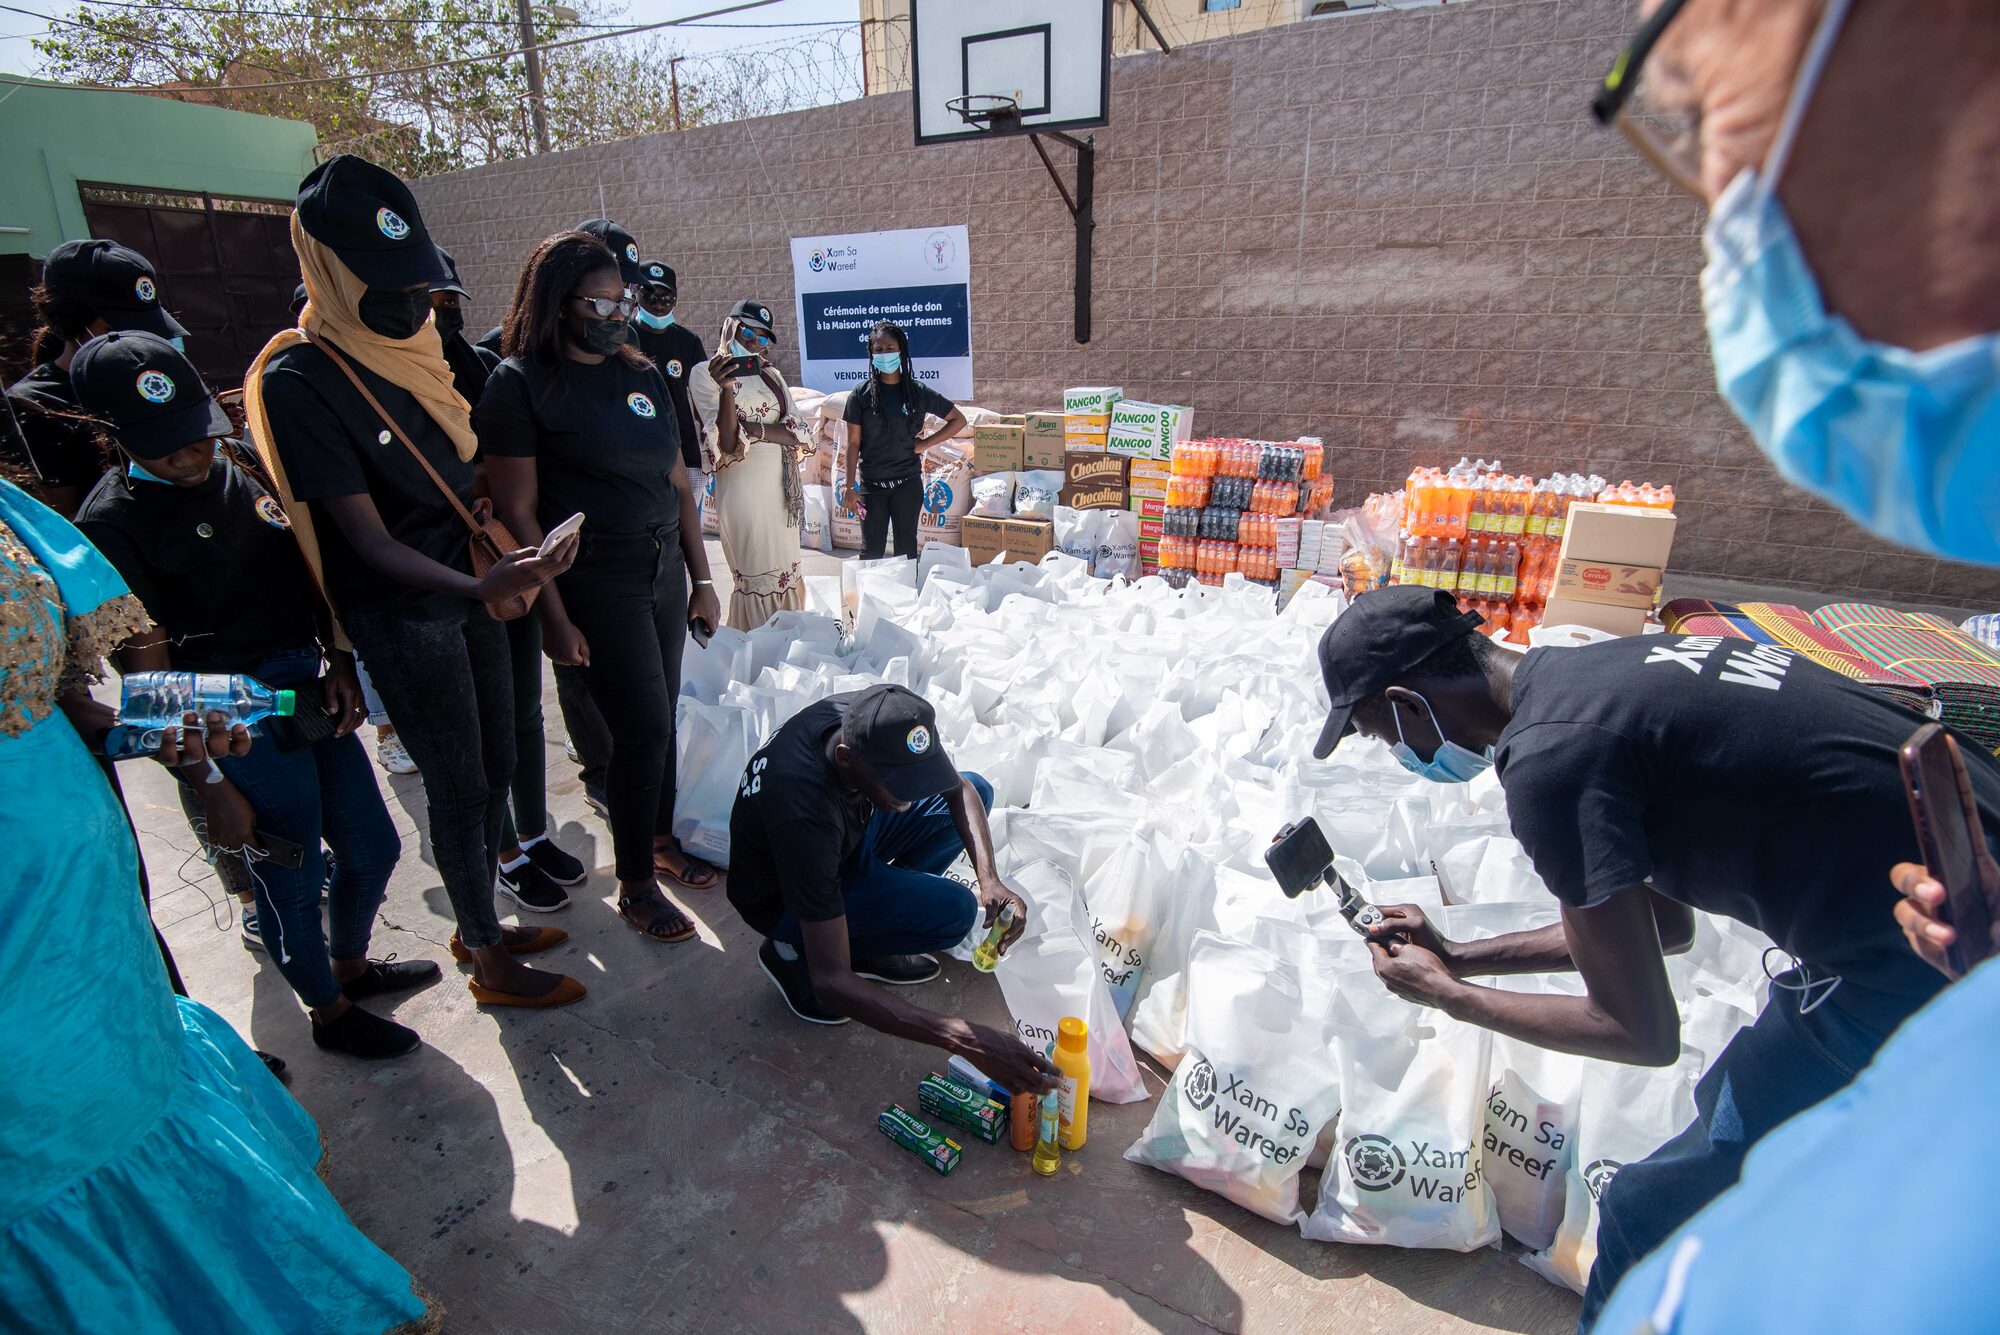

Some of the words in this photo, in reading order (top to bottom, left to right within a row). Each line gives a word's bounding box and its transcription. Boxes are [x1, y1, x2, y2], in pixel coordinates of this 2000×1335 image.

[827, 247, 845, 258] Xam
[846, 245, 857, 256] Sa
[827, 258, 857, 272] Wareef
[824, 305, 867, 316] Cérémonie
[868, 304, 879, 314] de
[881, 302, 910, 314] remise
[911, 302, 924, 312] de
[924, 301, 942, 312] don
[816, 320, 822, 331] à
[823, 320, 831, 330] la
[832, 319, 861, 330] Maison
[914, 317, 952, 327] Femmes
[858, 333, 869, 342] de
[834, 371, 868, 380] VENDRE
[919, 370, 939, 379] 2021
[1066, 395, 1101, 410] KANGOO
[1113, 412, 1156, 424] KANGOO
[1109, 437, 1152, 448] KANGOO
[1160, 411, 1170, 459] KANGOO
[1070, 456, 1123, 480] Chocolion
[704, 495, 716, 509] GM
[1071, 487, 1123, 508] Chocolion
[921, 513, 946, 527] GMD
[1065, 547, 1081, 555] Xam
[1082, 547, 1091, 555] Sa
[1112, 544, 1128, 552] Xam
[1129, 543, 1137, 551] Sa
[1113, 552, 1136, 560] Wareef
[752, 757, 767, 794] Sa
[1091, 917, 1122, 957] Xam
[1123, 949, 1142, 967] Sa
[931, 1075, 967, 1097] DENTYGEL
[1221, 1073, 1278, 1122] Xam
[1284, 1107, 1309, 1139] Sa
[892, 1107, 927, 1133] DENTYGEL
[1486, 1085, 1528, 1134] Xam
[1534, 1121, 1565, 1151] Sa
[1213, 1104, 1301, 1166] Wareef
[1411, 1140, 1470, 1169] Xam
[1483, 1123, 1557, 1181] areef
